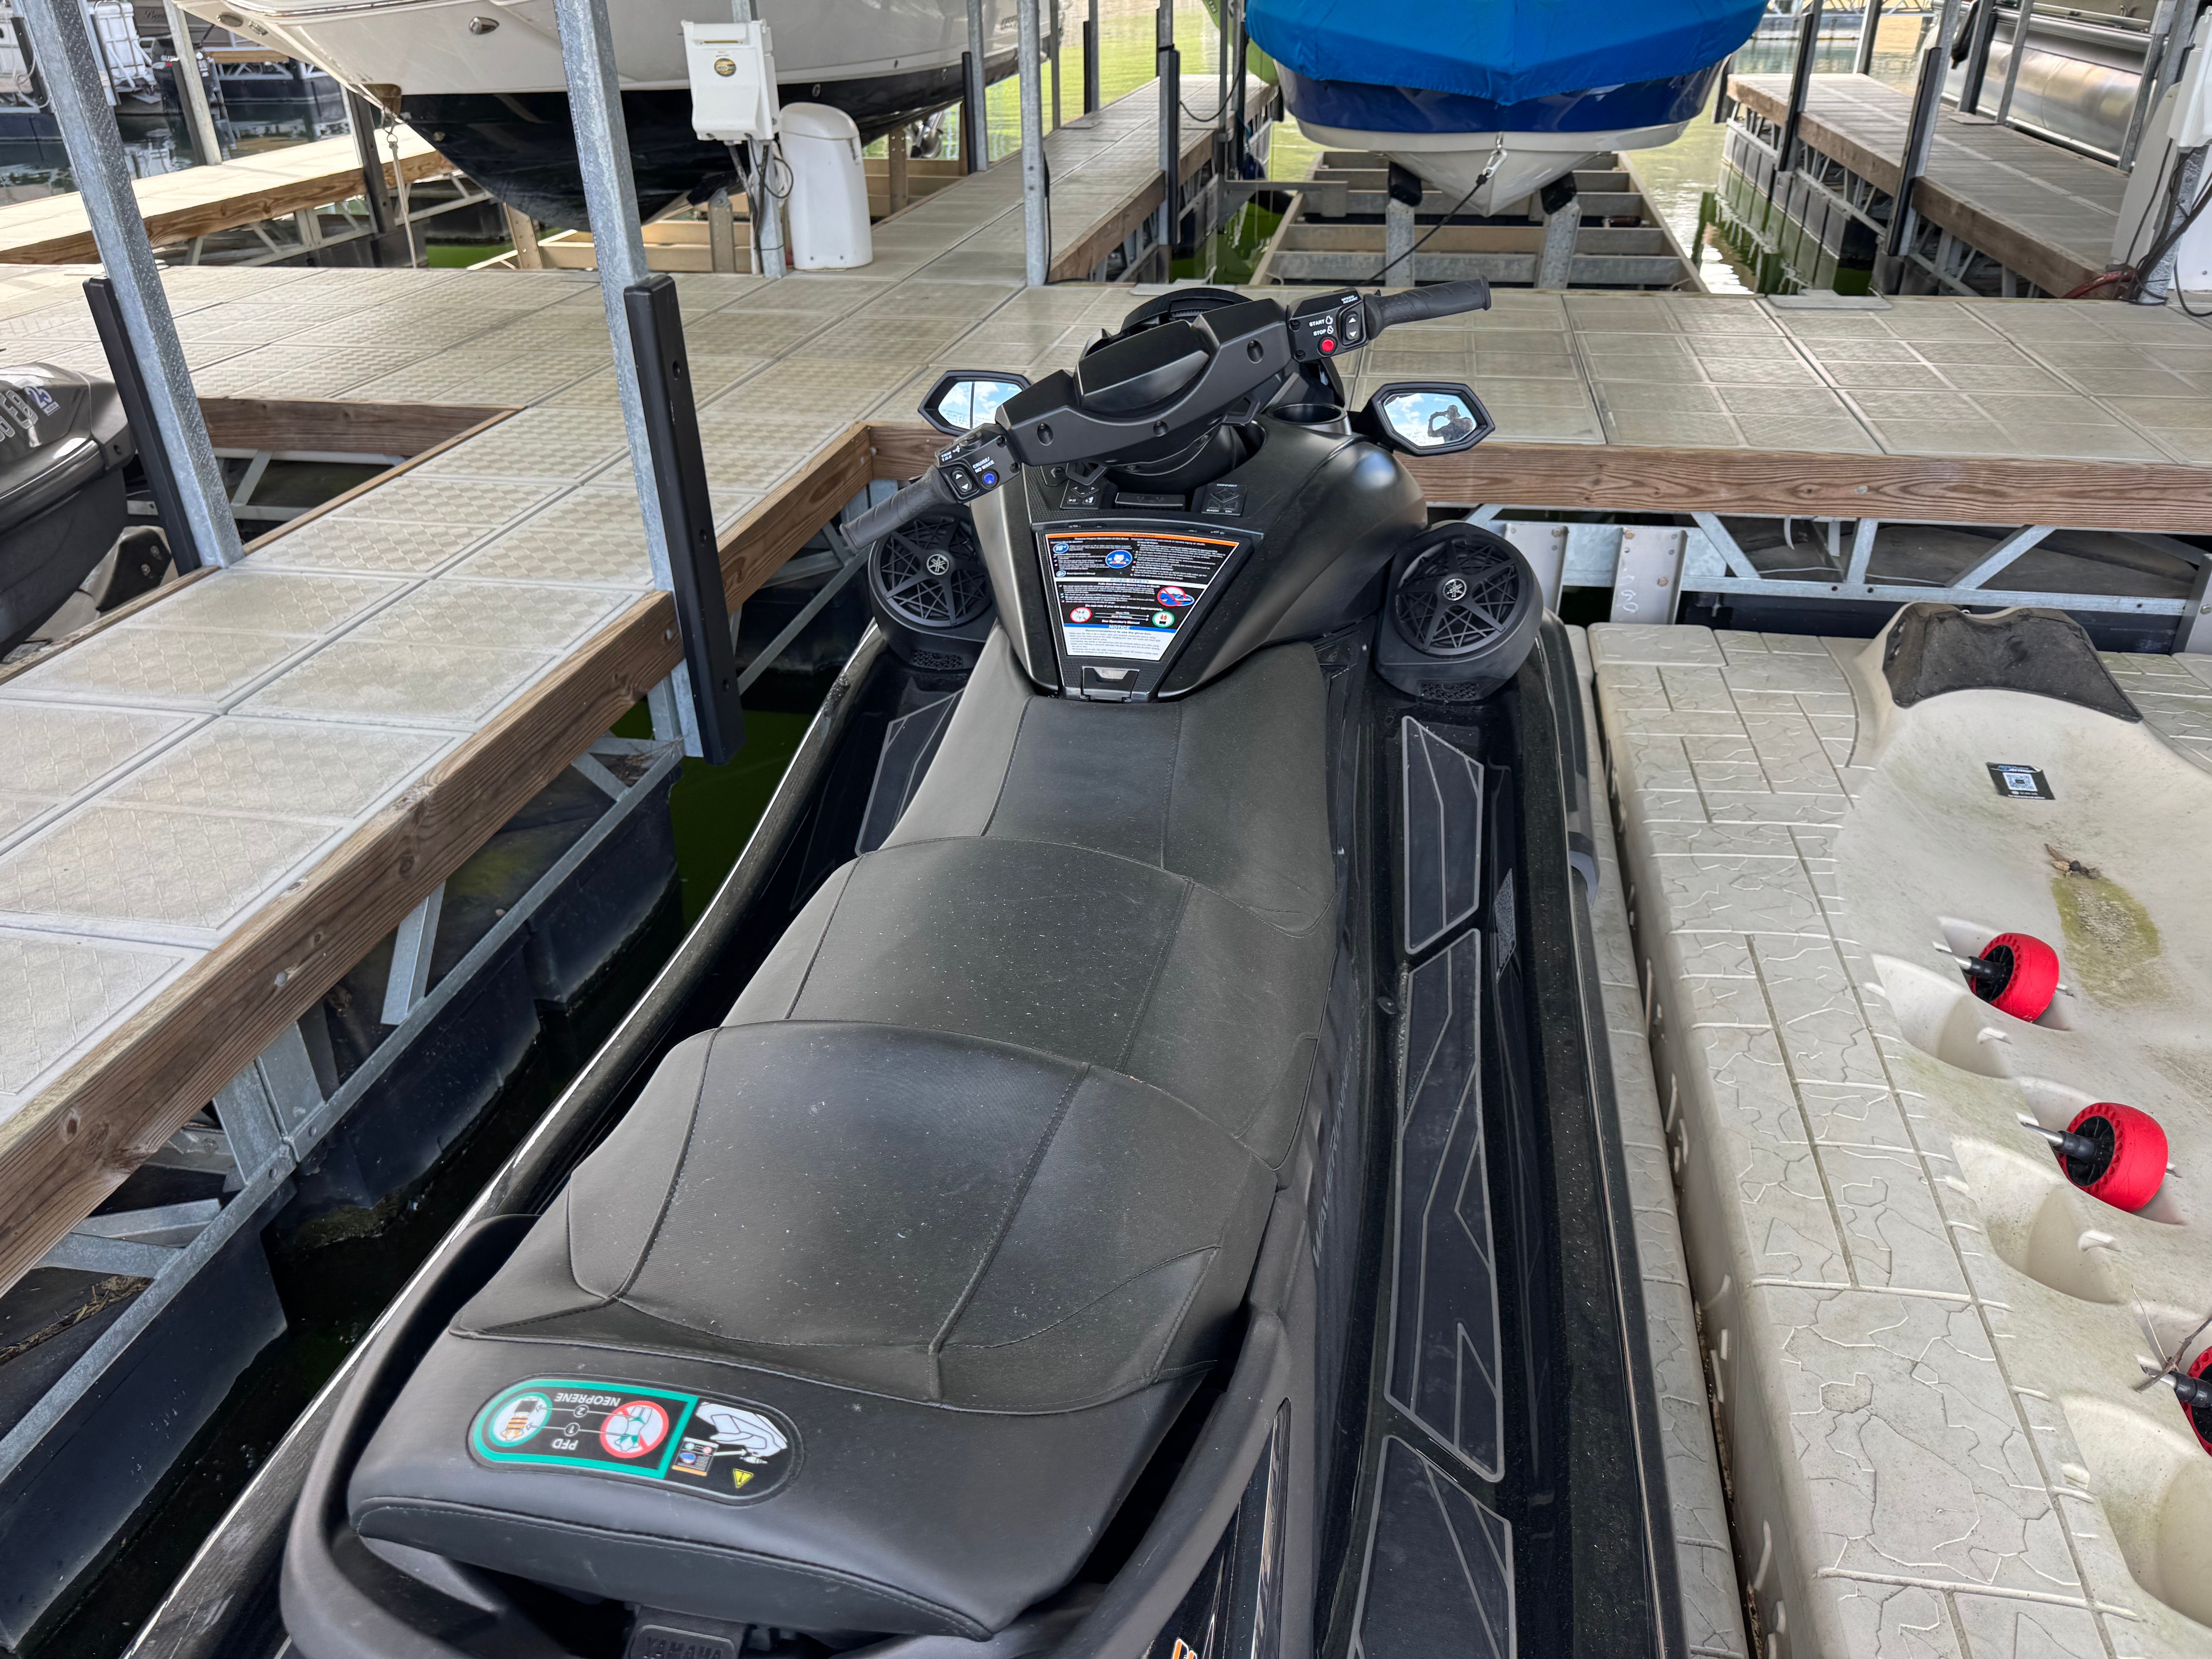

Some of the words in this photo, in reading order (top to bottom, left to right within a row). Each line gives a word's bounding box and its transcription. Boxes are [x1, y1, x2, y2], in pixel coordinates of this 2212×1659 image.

[1309, 319, 1325, 327] START
[24, 387, 52, 408] 25
[982, 460, 995, 470] WAKE
[1313, 1034, 1353, 1268] WAVERUNNER
[554, 1392, 621, 1407] NEOPRENE
[578, 1407, 586, 1415] 2
[568, 1425, 575, 1434] 1
[551, 1438, 579, 1451] PFD
